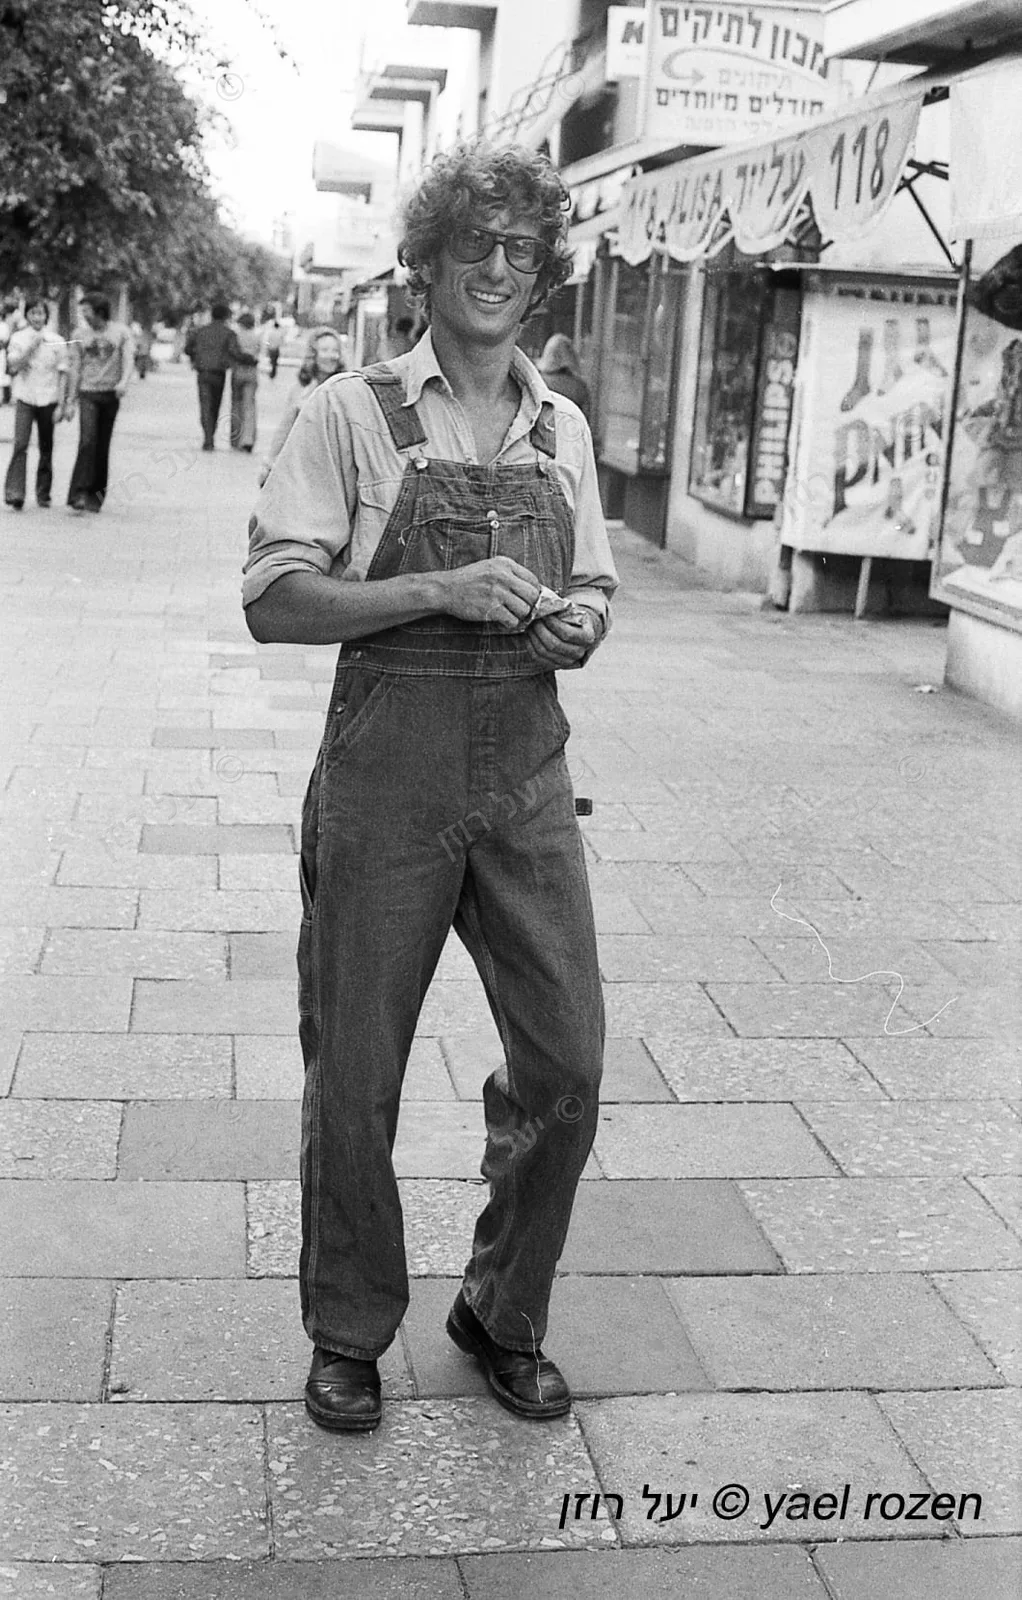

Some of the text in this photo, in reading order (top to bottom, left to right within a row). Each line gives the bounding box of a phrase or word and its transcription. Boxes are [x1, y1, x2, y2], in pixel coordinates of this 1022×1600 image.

[660, 7, 830, 79] מכון לתיקים
[656, 87, 739, 112] מיוחדים
[830, 118, 889, 210] 118
[753, 358, 794, 504] PHILIPS
